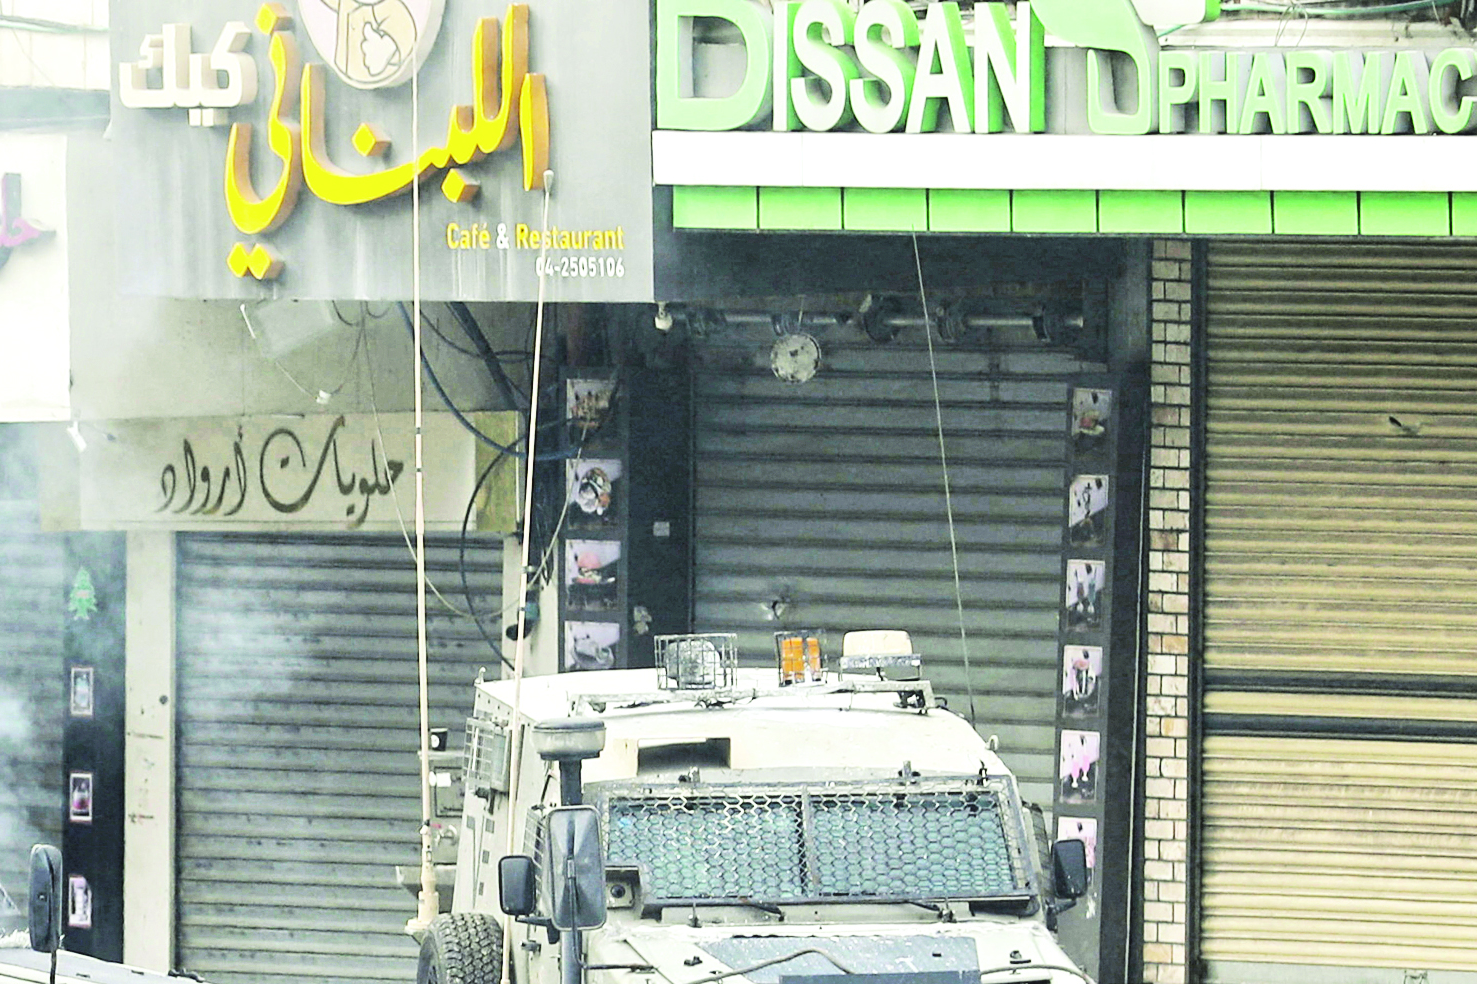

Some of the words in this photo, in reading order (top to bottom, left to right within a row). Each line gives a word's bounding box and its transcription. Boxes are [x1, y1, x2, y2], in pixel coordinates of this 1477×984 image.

[119, 21, 258, 127] كيك
[656, 0, 1045, 133] DISSAN
[1158, 48, 1477, 134] PHARMAC
[225, 3, 550, 280] اللبناني
[446, 222, 491, 250] Café
[496, 222, 509, 250] &
[515, 223, 624, 250] Restaurant
[535, 256, 624, 278] 04-2505106
[259, 414, 405, 529] حلويات
